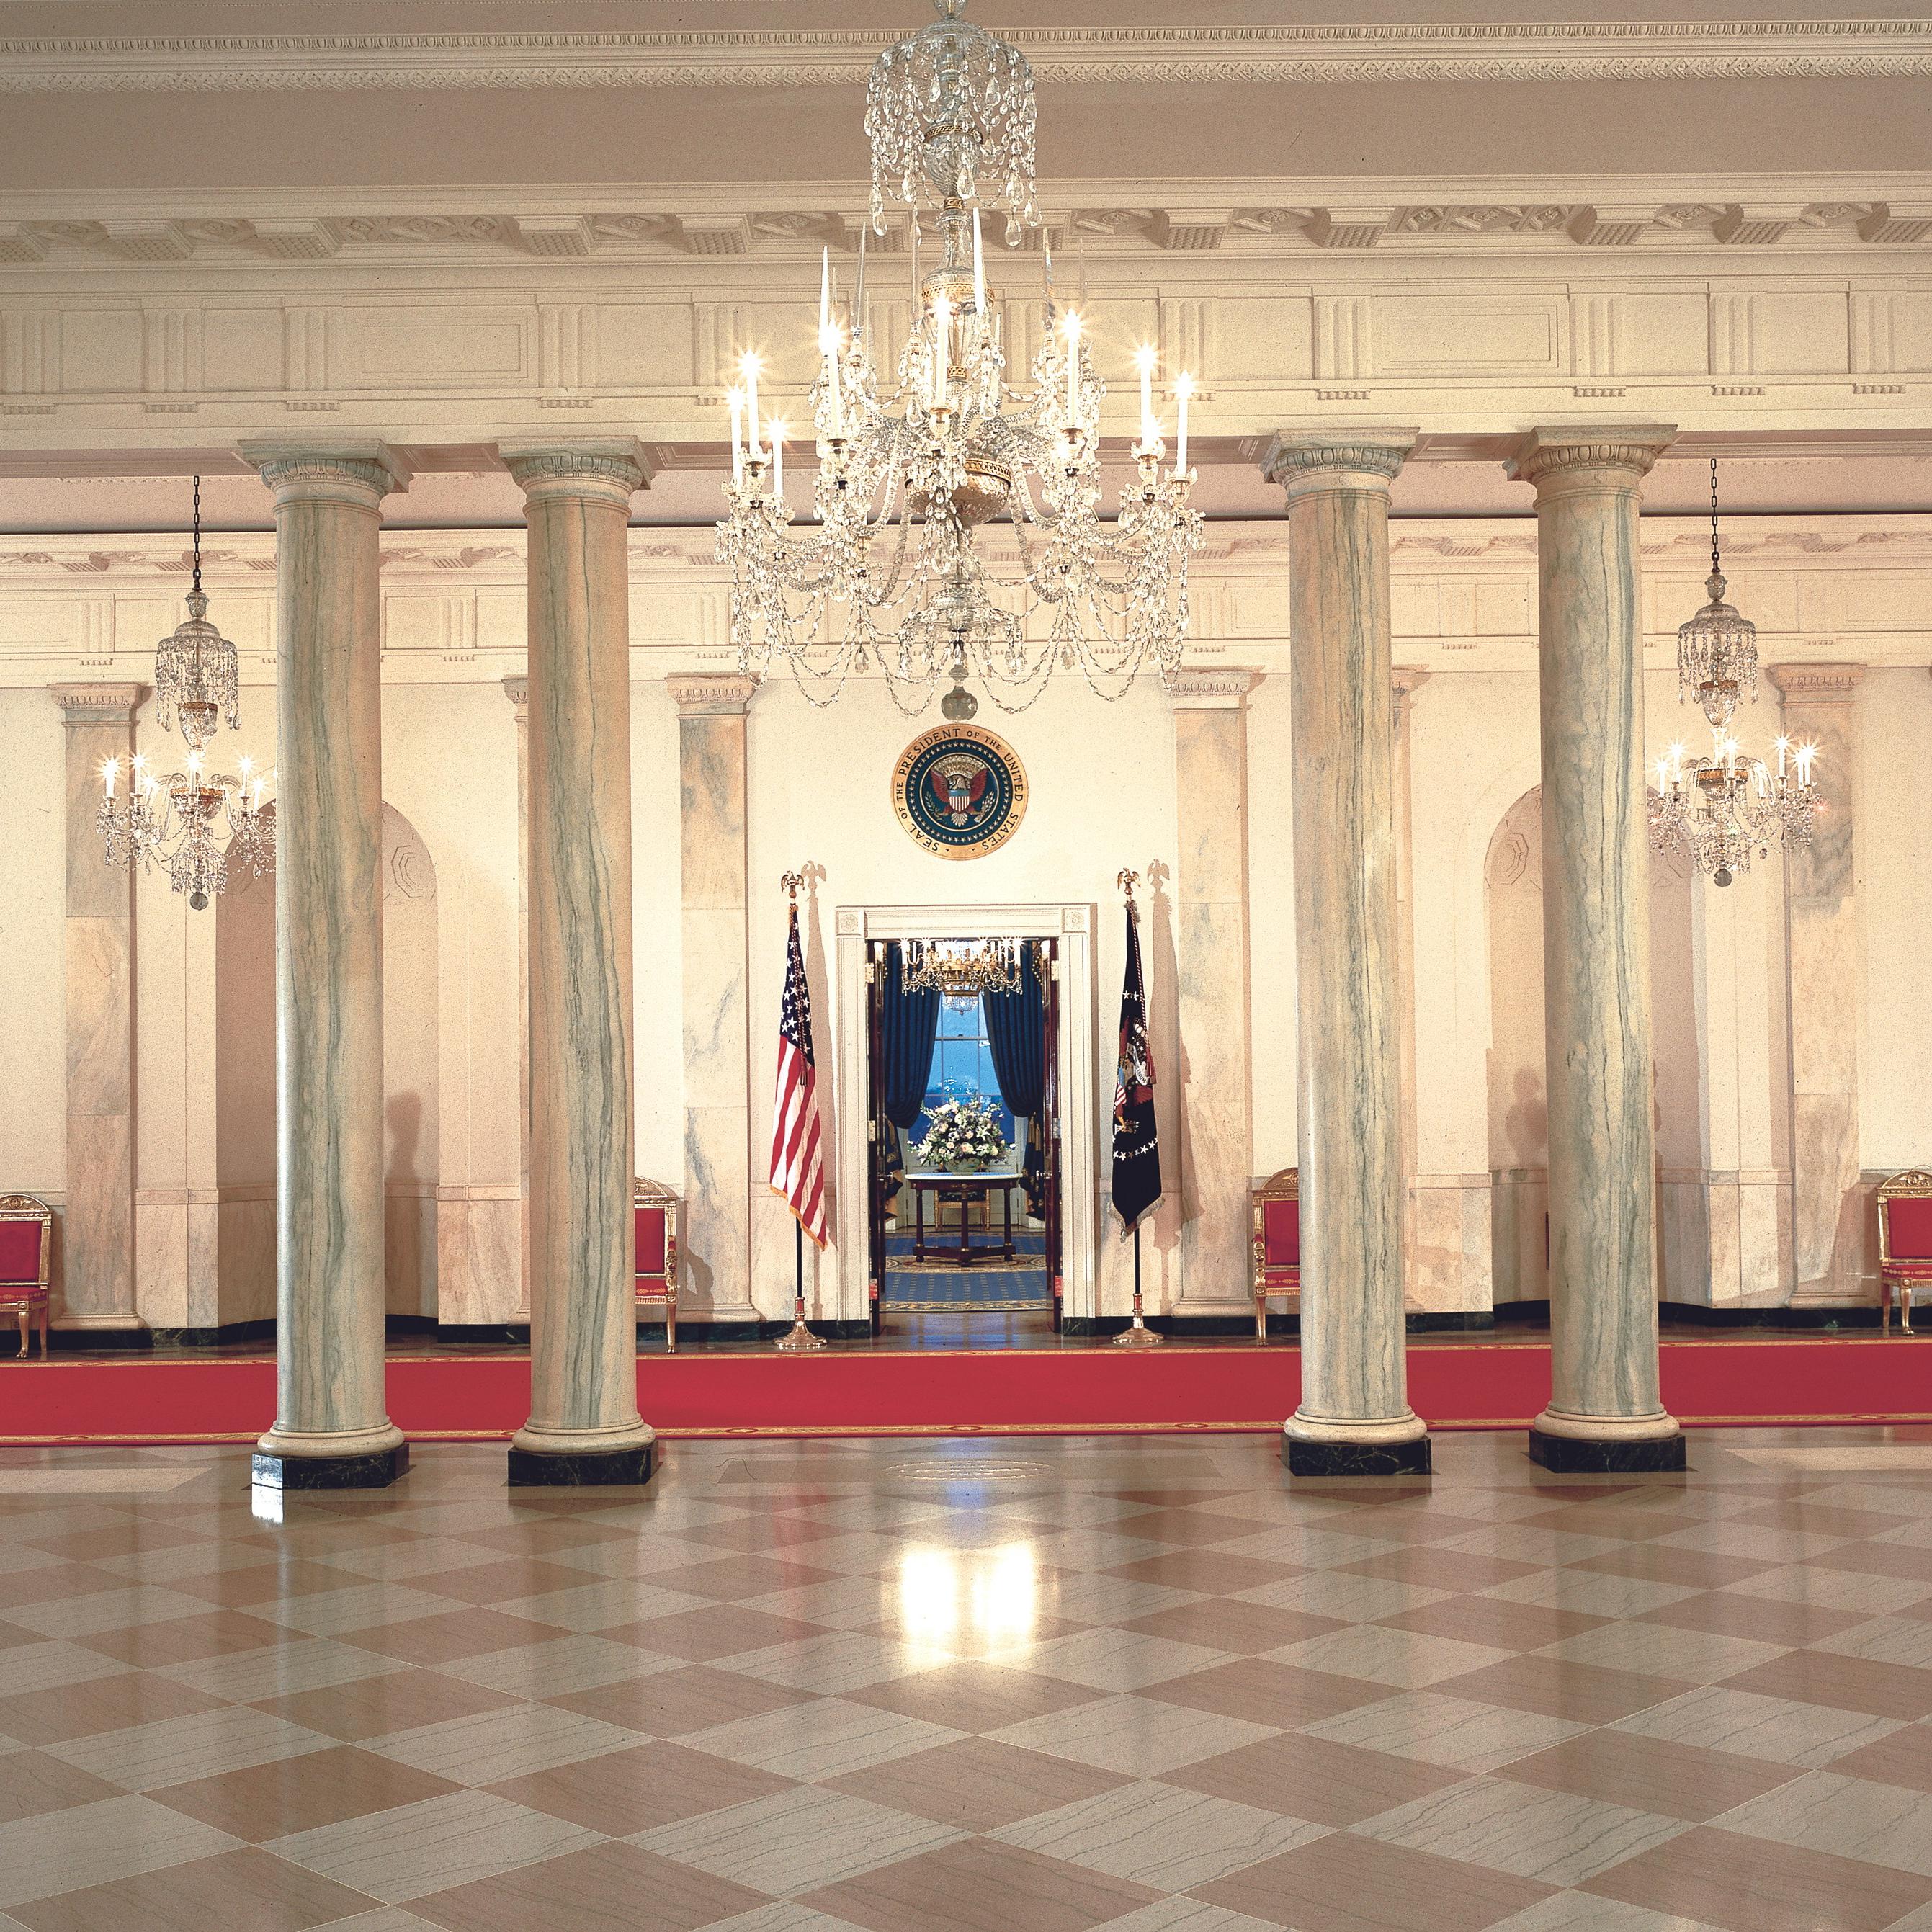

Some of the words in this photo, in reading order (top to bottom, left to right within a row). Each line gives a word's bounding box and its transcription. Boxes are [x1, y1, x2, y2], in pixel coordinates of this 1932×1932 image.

[899, 728, 961, 776] PRESIDENT
[984, 736, 1002, 751] THE
[1003, 753, 1023, 802] UNITED
[898, 807, 908, 820] OF
[910, 823, 940, 851] SEAL
[982, 813, 1019, 851] STATES
